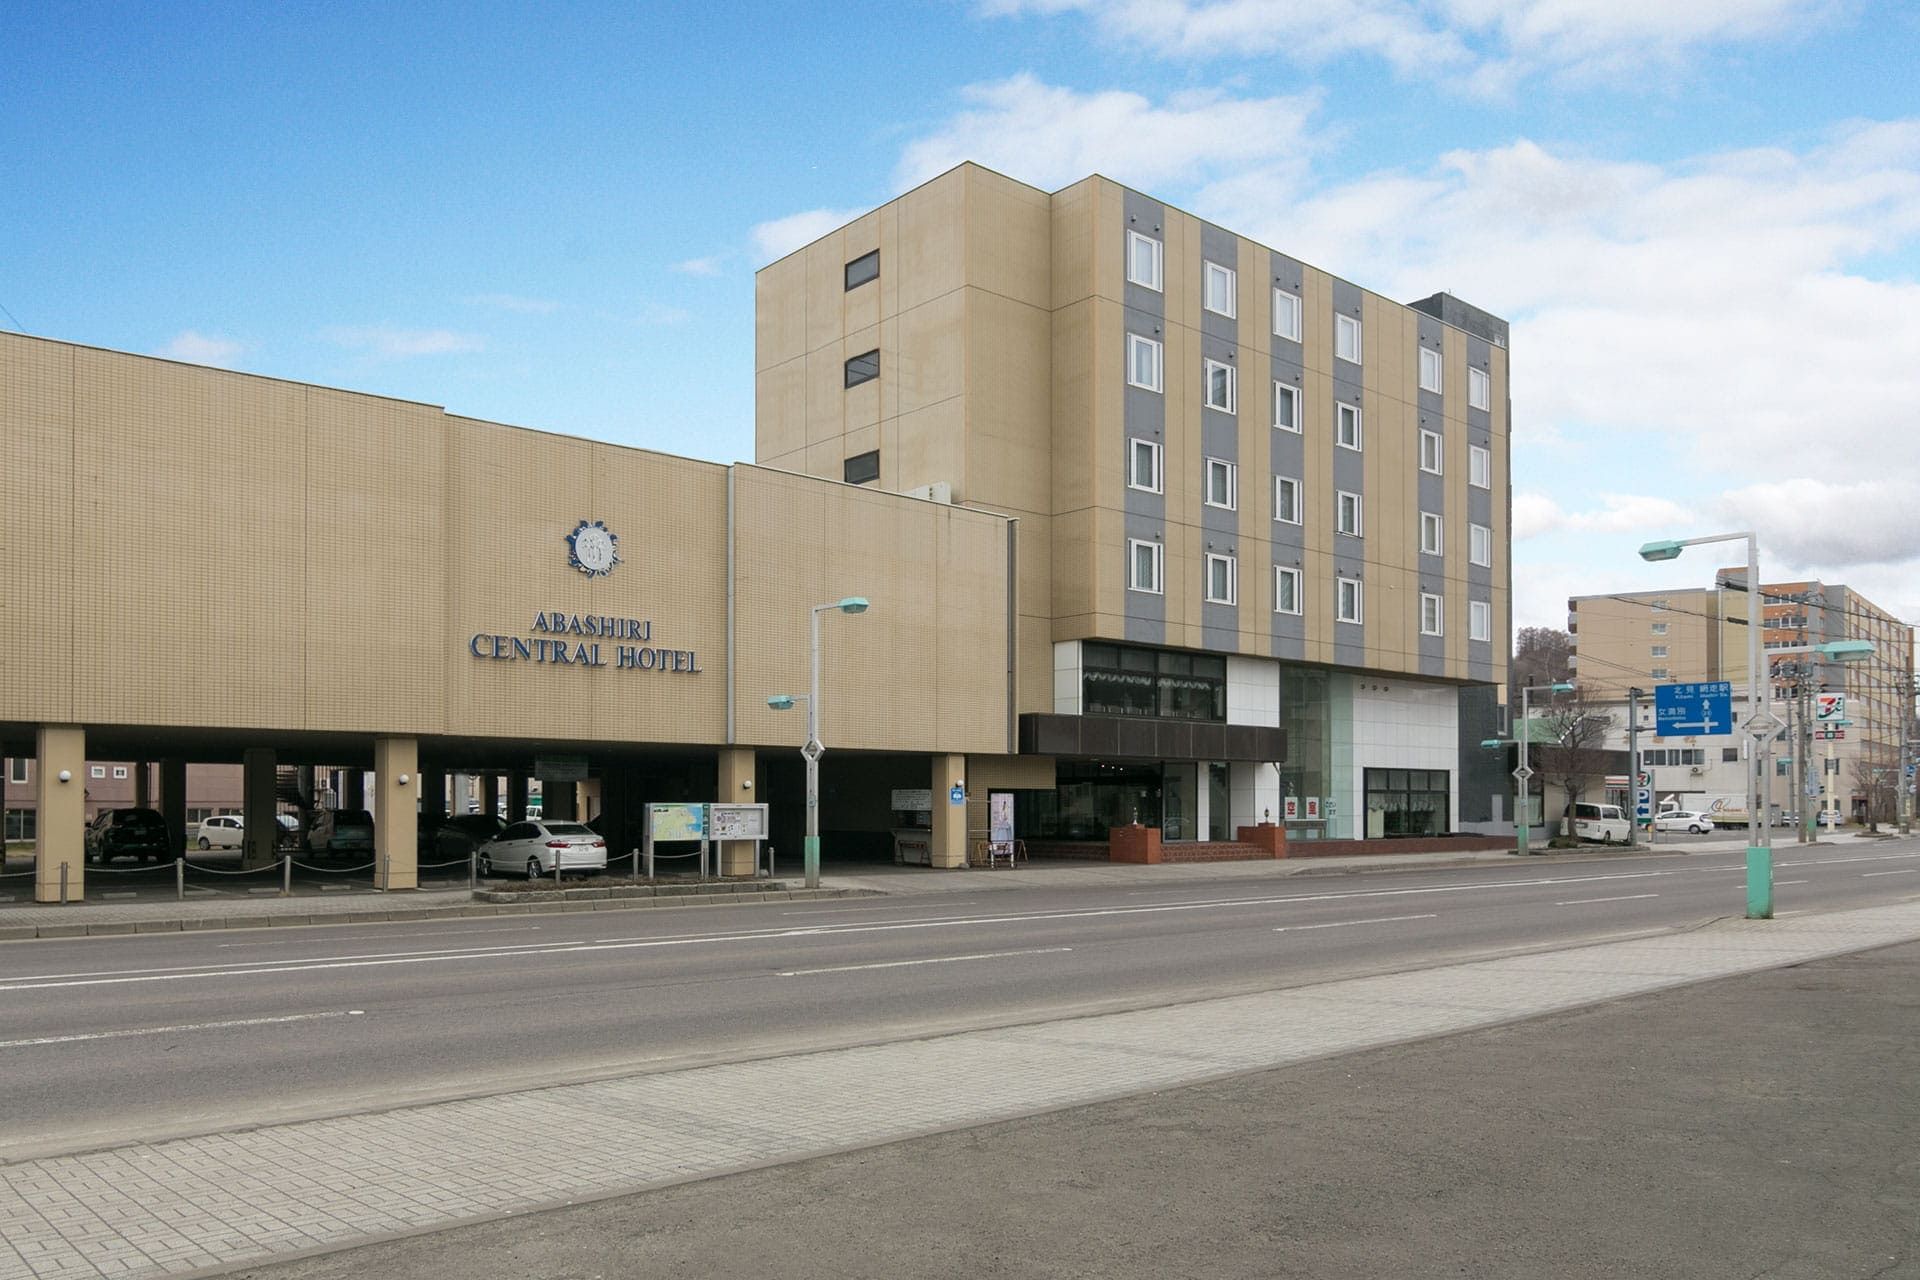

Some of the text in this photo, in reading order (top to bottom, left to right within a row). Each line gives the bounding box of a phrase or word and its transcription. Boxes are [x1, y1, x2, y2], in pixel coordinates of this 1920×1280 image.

[531, 610, 651, 641] ABASHIRI
[469, 633, 703, 673] CENTRAL HOTEL
